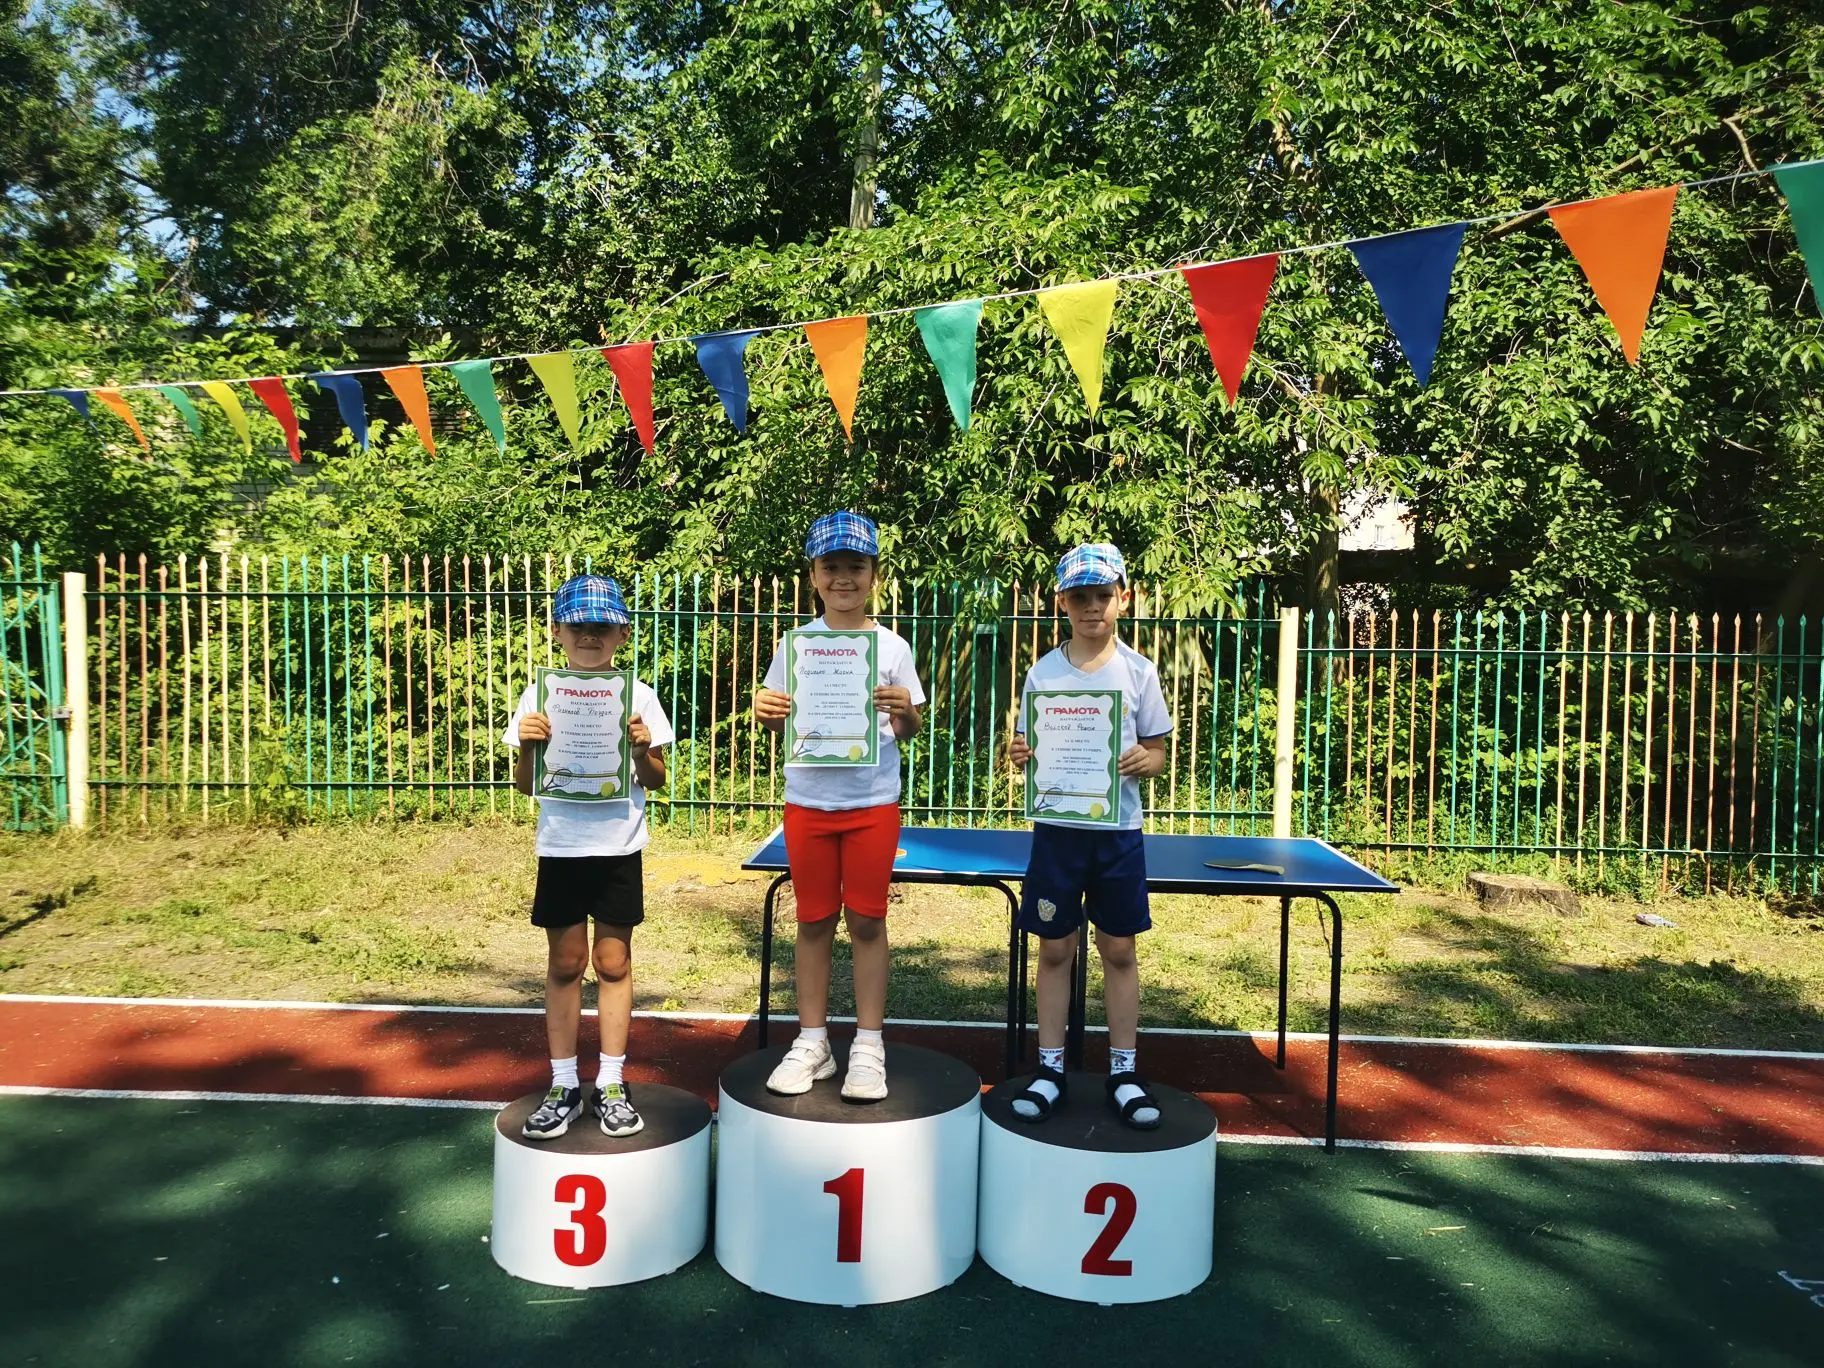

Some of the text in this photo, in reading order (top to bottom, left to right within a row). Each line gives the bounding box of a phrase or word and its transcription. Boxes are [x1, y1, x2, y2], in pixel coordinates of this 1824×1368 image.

[804, 648, 858, 657] ГРАМОТА
[555, 687, 613, 698] ГРАМОТА
[1045, 707, 1101, 715] ГРАМОТА
[554, 1175, 606, 1266] 3
[825, 1169, 864, 1261] 1
[1083, 1184, 1136, 1274] 2
